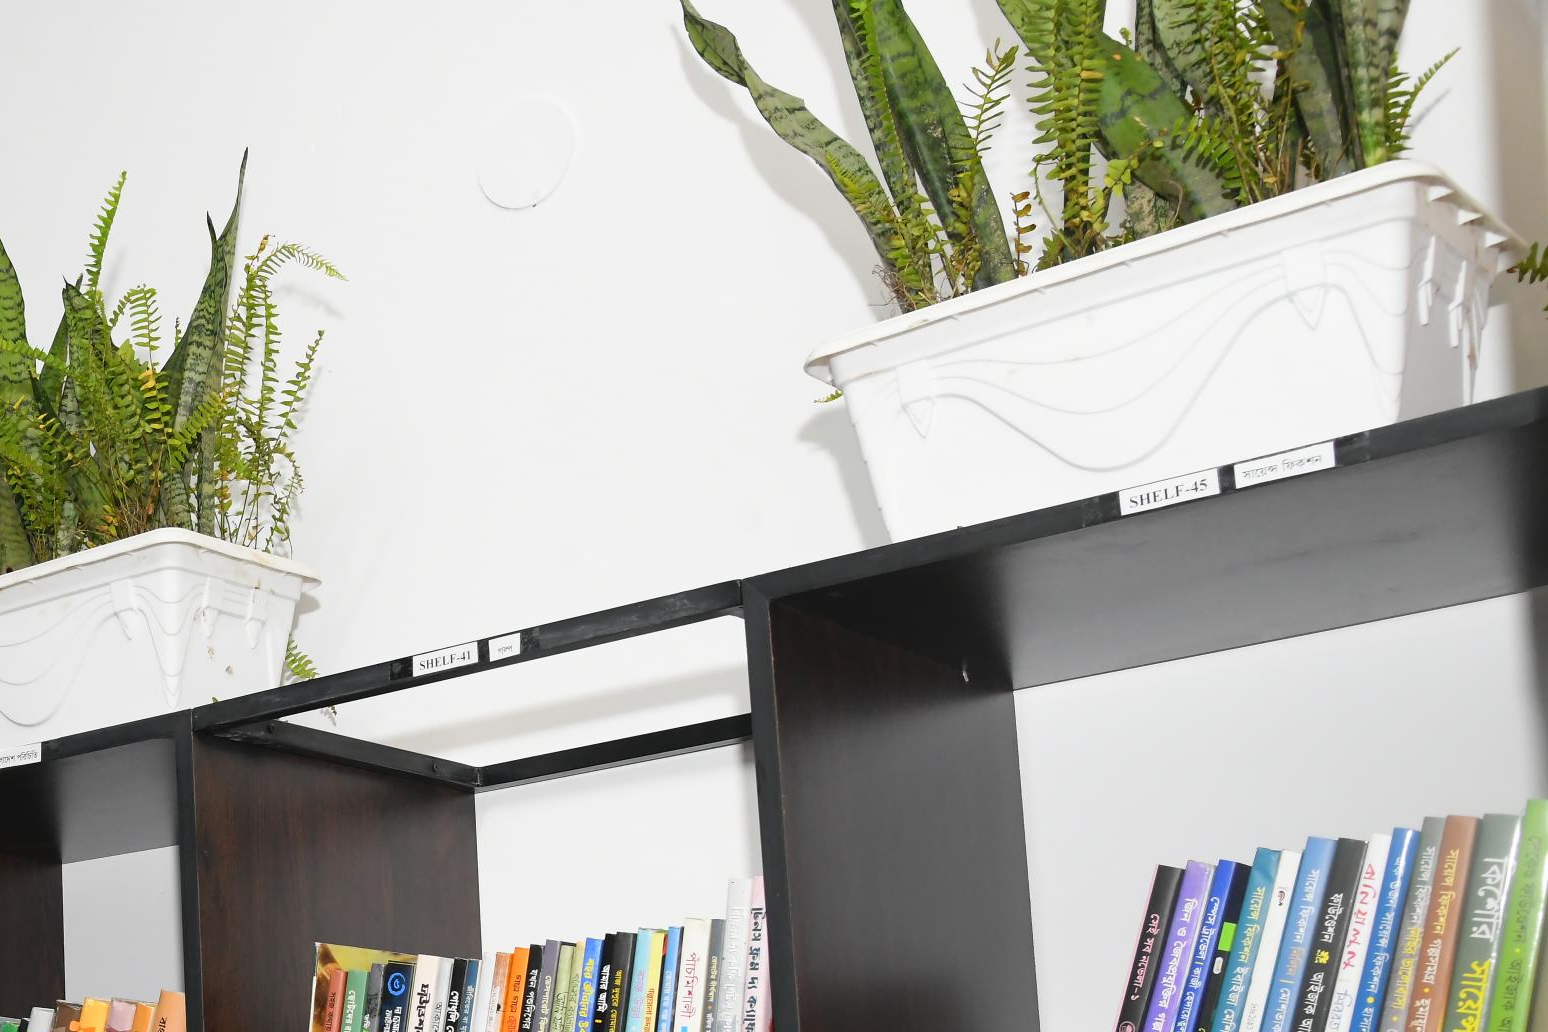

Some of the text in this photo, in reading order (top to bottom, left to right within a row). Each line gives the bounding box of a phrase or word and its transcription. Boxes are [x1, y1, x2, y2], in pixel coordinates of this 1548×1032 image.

[1243, 455, 1323, 480] সায়েন্স ফিকশন
[1129, 478, 1208, 508] SHELF-45
[419, 650, 471, 670] SHELF-41
[1441, 848, 1459, 886] সায়েন্স
[1205, 896, 1219, 925] স্পেস
[1433, 891, 1455, 934] ফিকশন
[1468, 857, 1511, 942] কিশোর
[1146, 913, 1160, 935] সেই
[1142, 937, 1154, 953] সব
[1192, 924, 1216, 961] ট্রাভেল
[1151, 896, 1198, 1032] জিন ও জৈবপ্রযুক্তির গল্প
[1185, 966, 1203, 989] কাজী
[1422, 938, 1441, 983] গল্পসমগ্র
[680, 952, 698, 1018] পাঁচমিশালী
[445, 989, 462, 1023] গোধূলি
